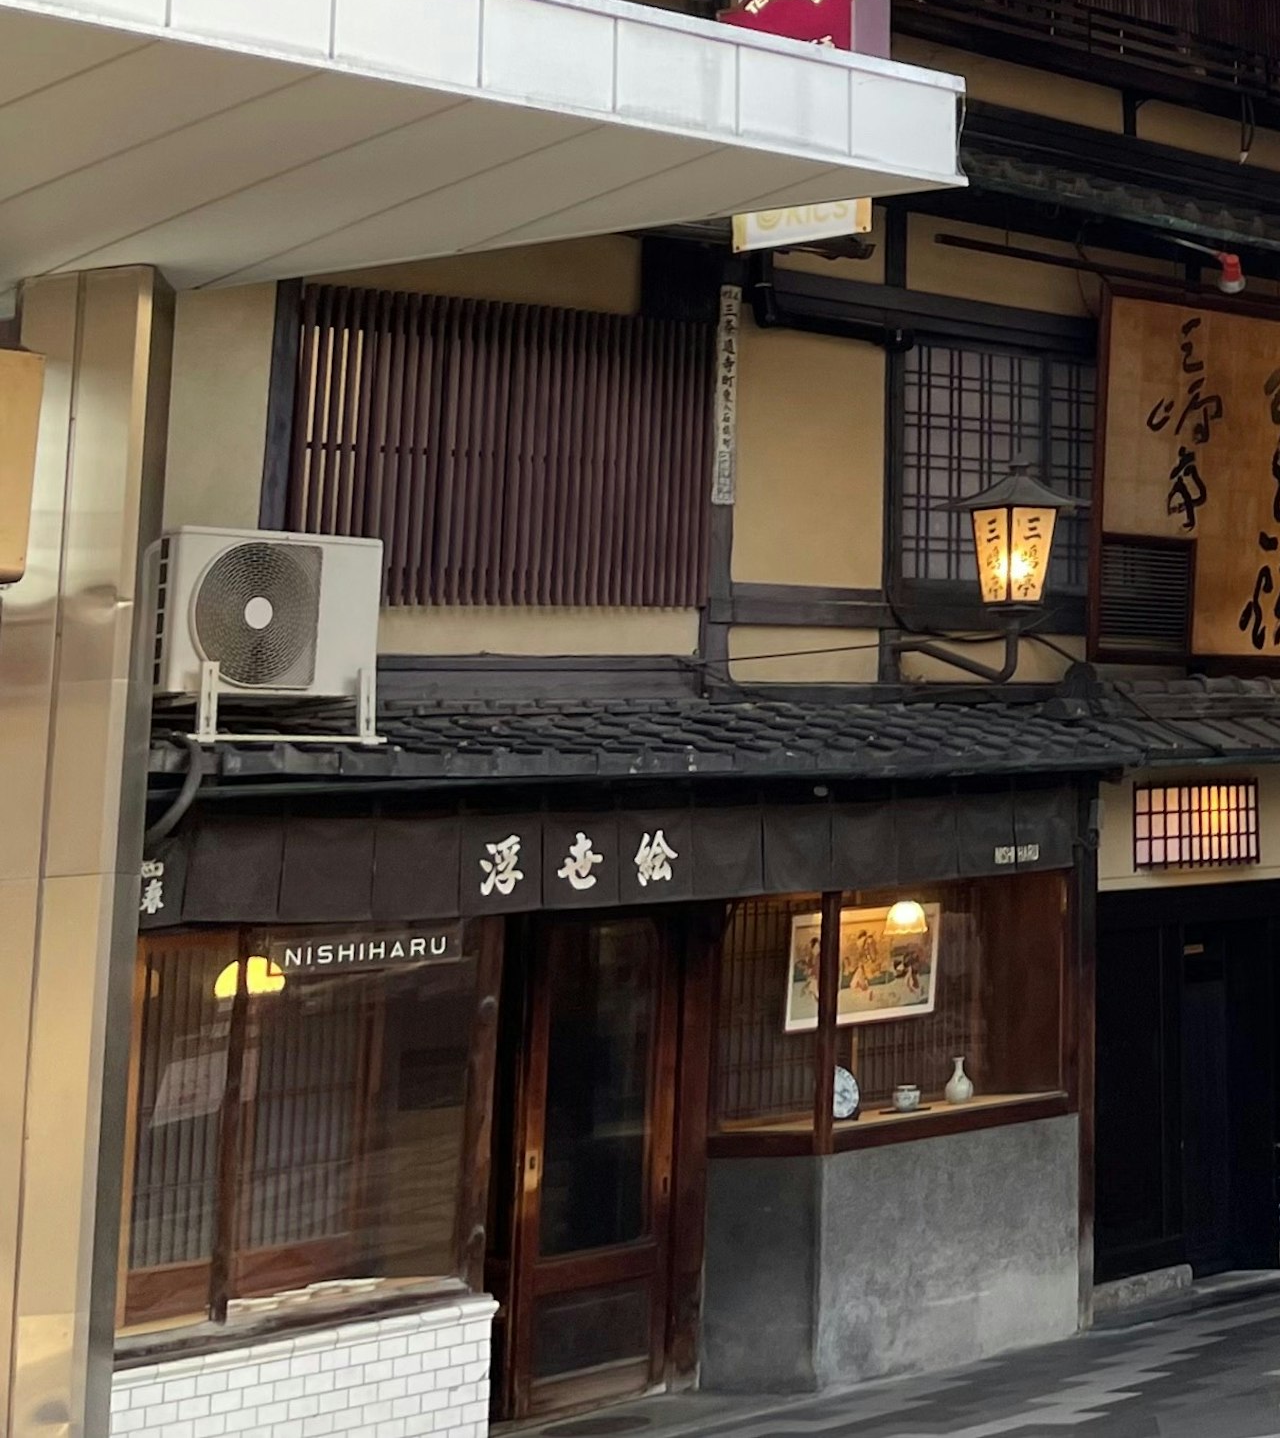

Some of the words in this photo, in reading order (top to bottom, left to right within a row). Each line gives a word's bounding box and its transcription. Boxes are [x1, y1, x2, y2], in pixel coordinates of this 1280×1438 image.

[479, 829, 679, 896] 浮世絵
[284, 935, 448, 967] NISHIHARU
